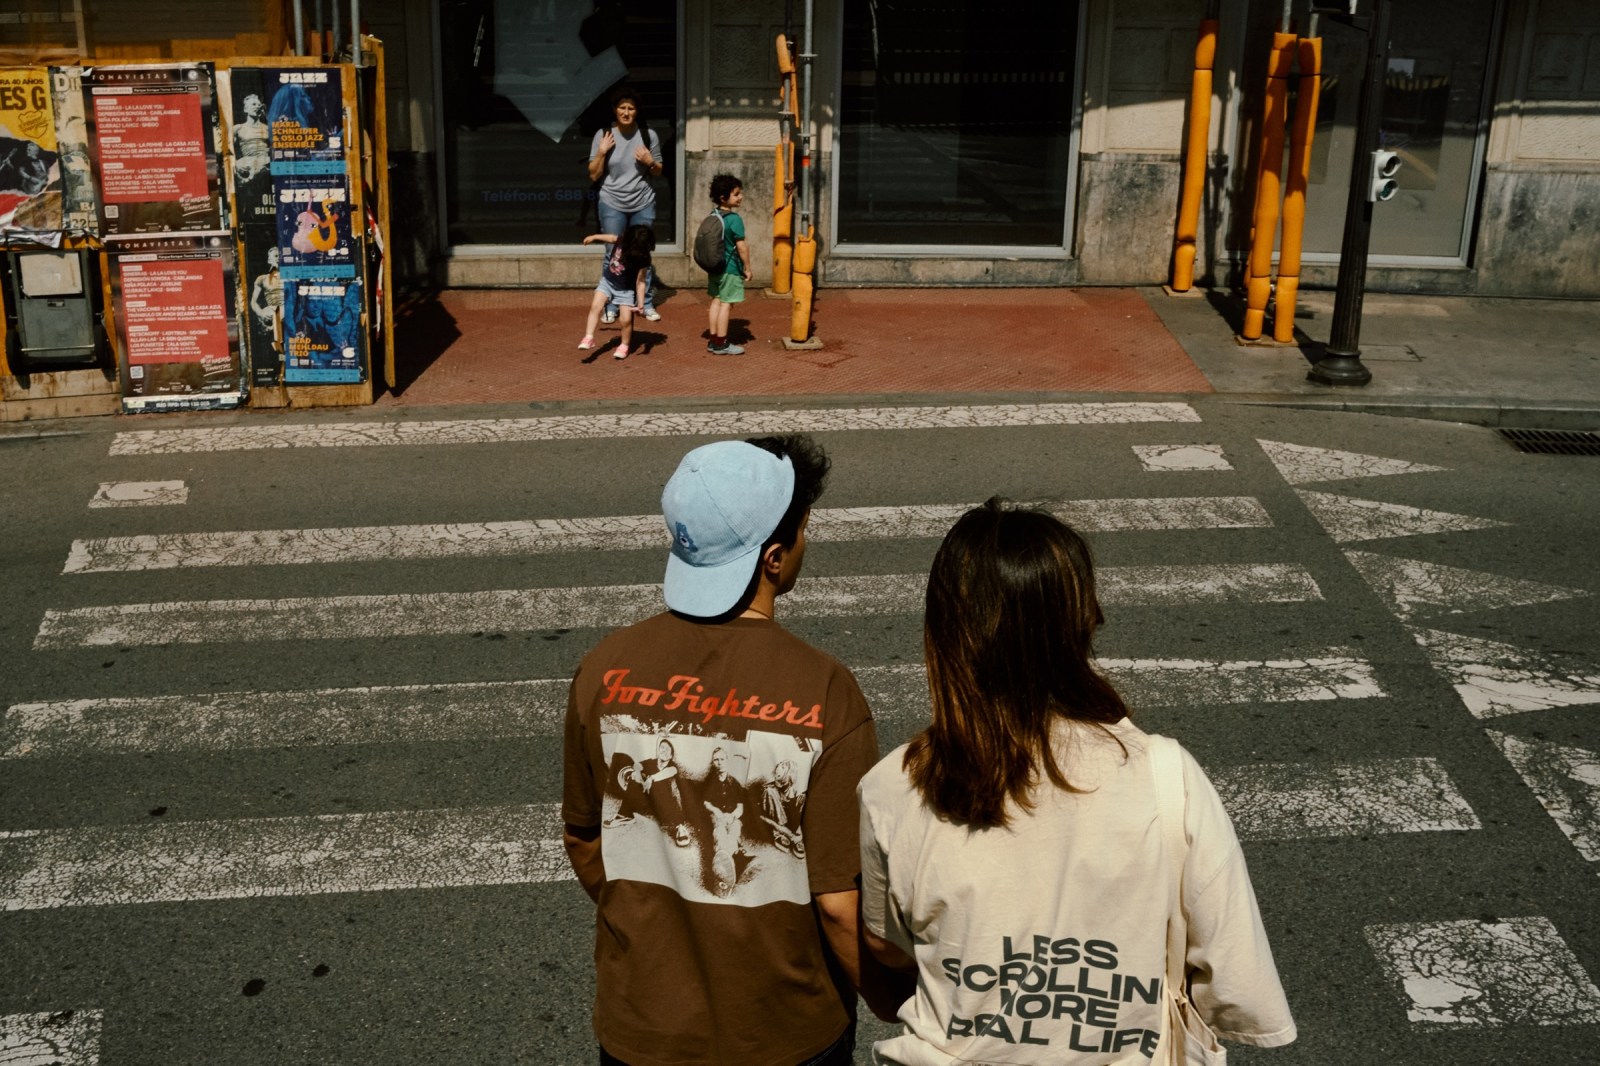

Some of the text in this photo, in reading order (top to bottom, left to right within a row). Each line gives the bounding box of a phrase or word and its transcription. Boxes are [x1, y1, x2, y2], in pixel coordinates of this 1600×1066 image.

[280, 73, 327, 84] JAZZ
[0, 86, 47, 110] ES G
[304, 134, 324, 142] JAZZ
[482, 190, 550, 202] Teléfono:
[554, 189, 582, 202] 688
[118, 241, 191, 249] TOMAVISTAS
[298, 286, 345, 296] JAZZ
[601, 669, 824, 728] Foo Fighters
[1002, 934, 1118, 970] LESS
[942, 958, 1165, 1004] SCROLLIN
[1000, 988, 1120, 1028] MORE
[1069, 1024, 1160, 1059] LIFE
